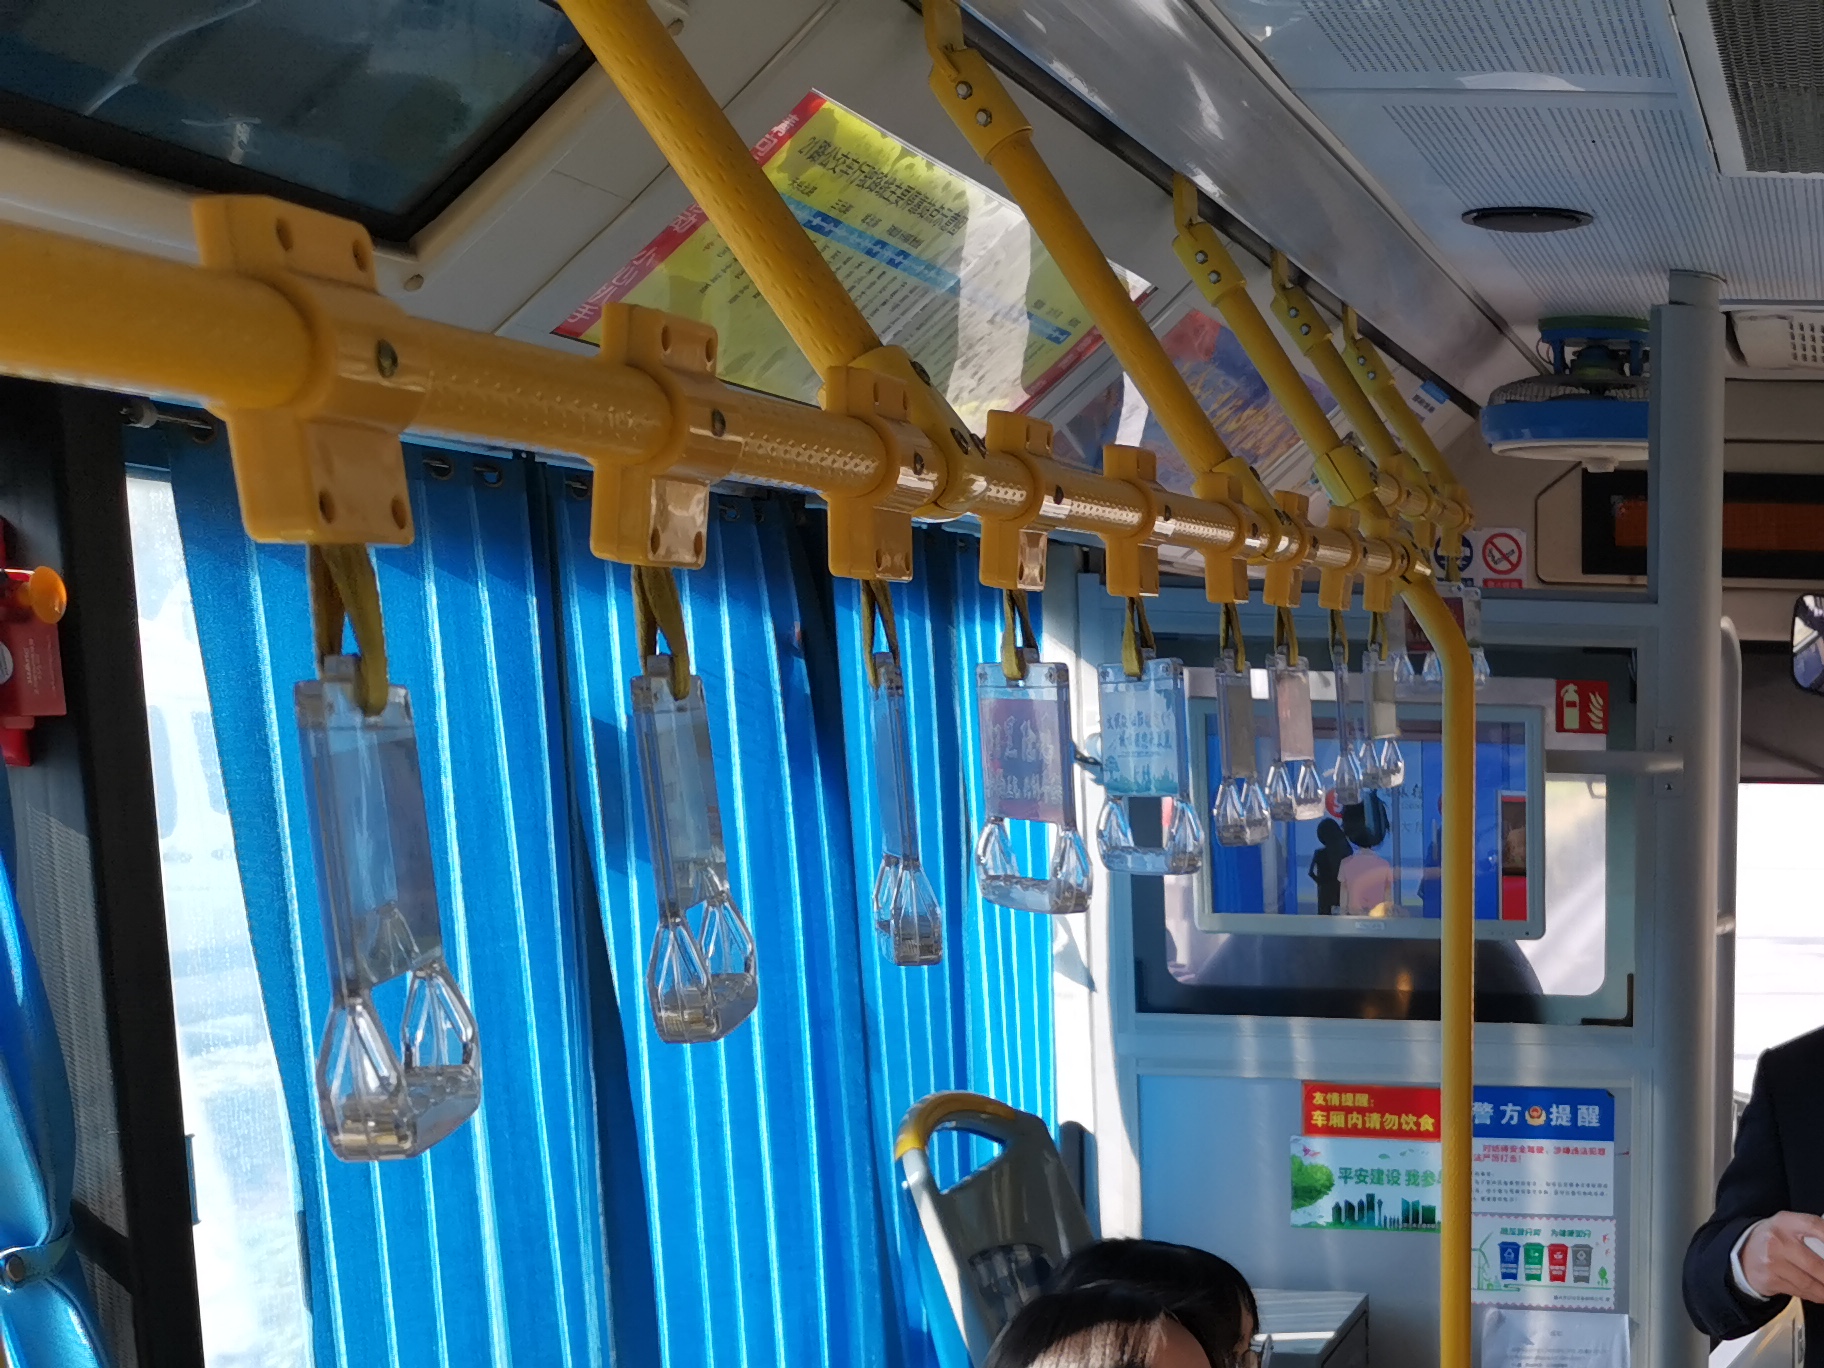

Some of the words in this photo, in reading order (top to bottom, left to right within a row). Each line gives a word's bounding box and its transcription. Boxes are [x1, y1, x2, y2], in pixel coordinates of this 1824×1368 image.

[1310, 1110, 1435, 1132] 车厢内请勿饮食
[1472, 1102, 1522, 1125] 警方
[1550, 1103, 1601, 1127] 提醒
[1338, 1167, 1401, 1186] 平安建设
